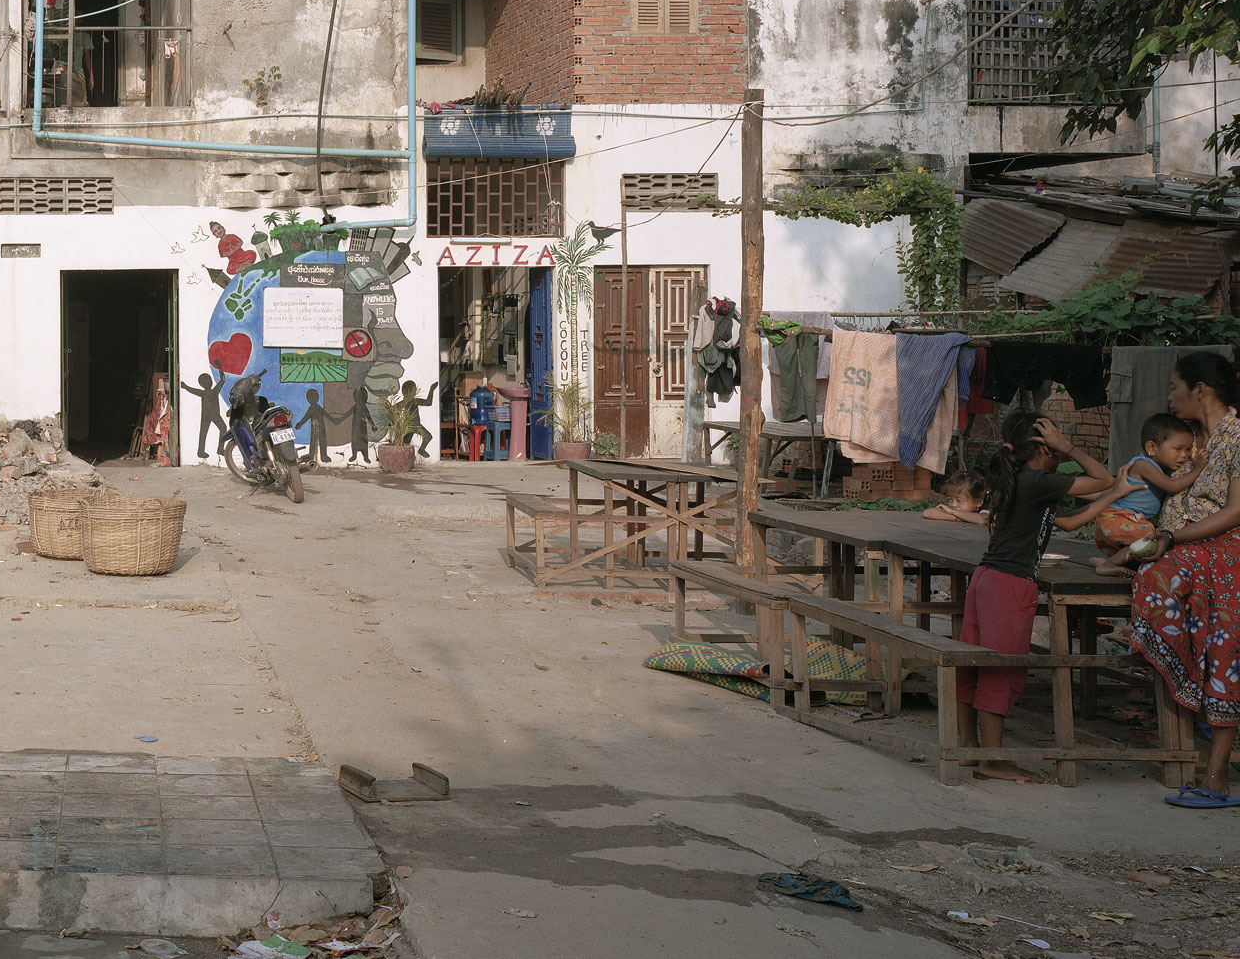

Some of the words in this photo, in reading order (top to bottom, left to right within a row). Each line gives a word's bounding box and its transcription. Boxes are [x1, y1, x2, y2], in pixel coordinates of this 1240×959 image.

[436, 245, 556, 265] AZIZA
[375, 307, 384, 315] IS
[559, 320, 569, 392] COCONUT
[580, 329, 590, 372] TREE
